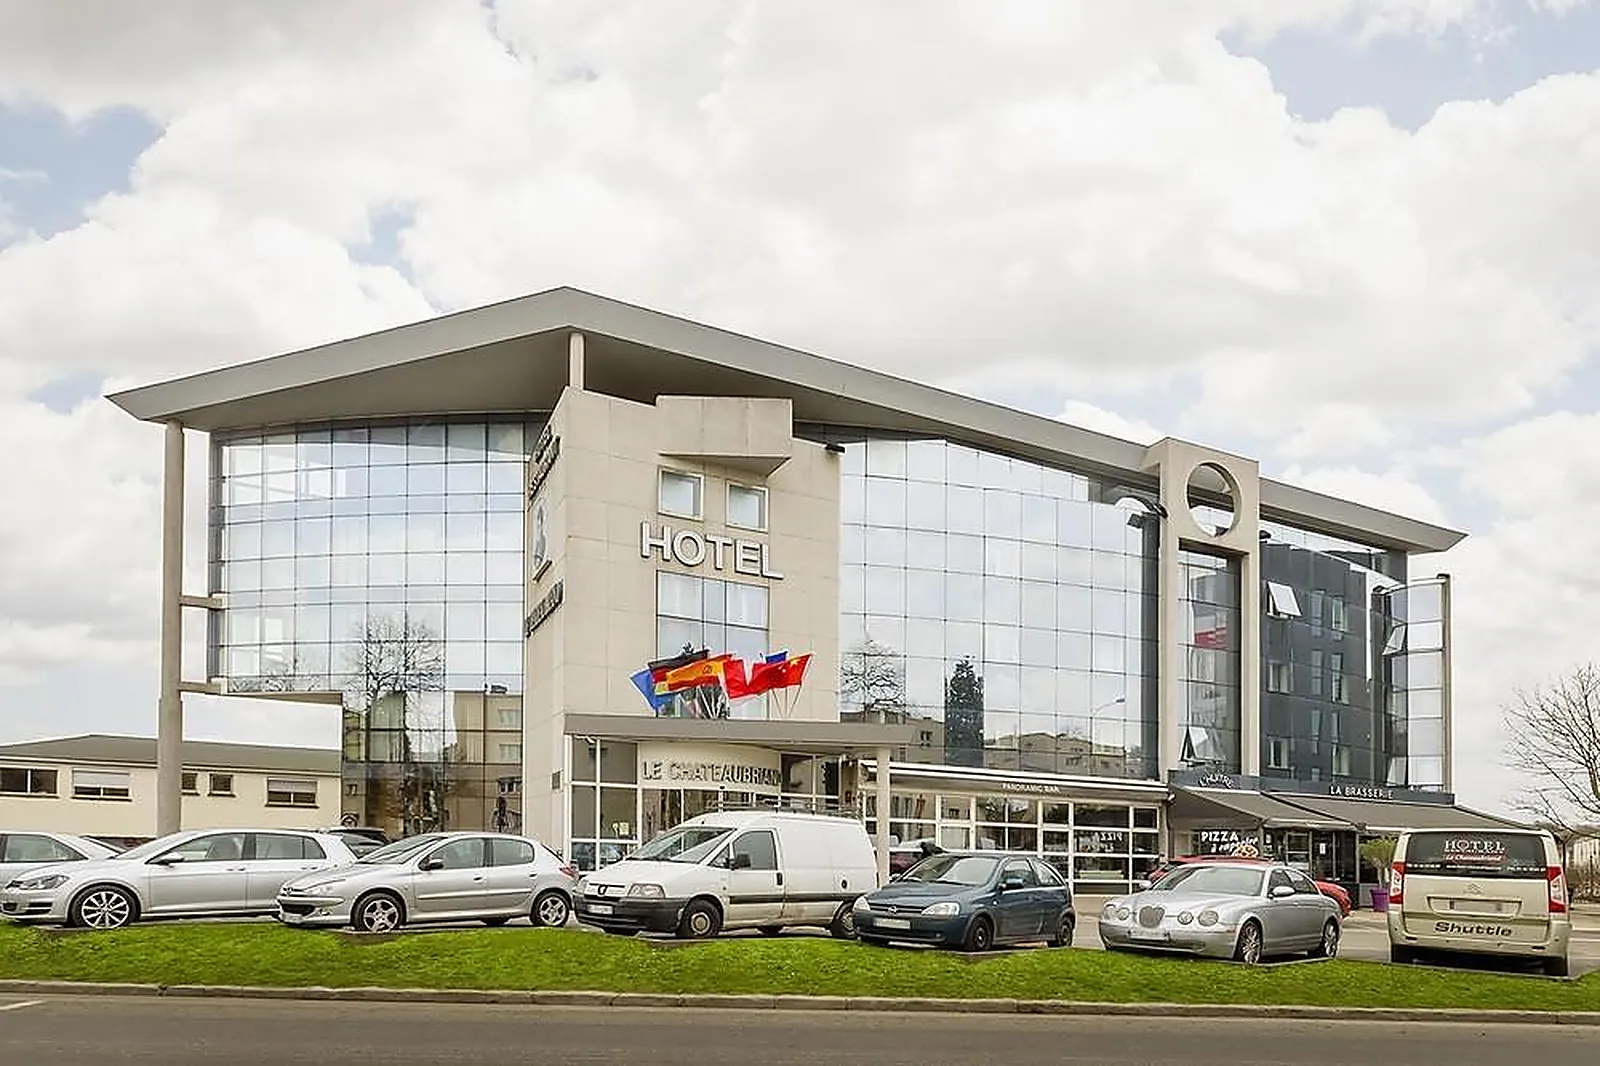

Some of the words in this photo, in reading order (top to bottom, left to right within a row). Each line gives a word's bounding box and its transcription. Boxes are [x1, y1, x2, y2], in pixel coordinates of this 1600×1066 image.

[640, 521, 784, 580] HOTEL
[643, 761, 663, 780] LE
[1329, 785, 1342, 795] LA
[1344, 786, 1394, 800] BRASSERIE
[1201, 831, 1239, 842] PIZZA
[1445, 839, 1505, 851] HOTEL
[1434, 921, 1512, 937] Shuttle
